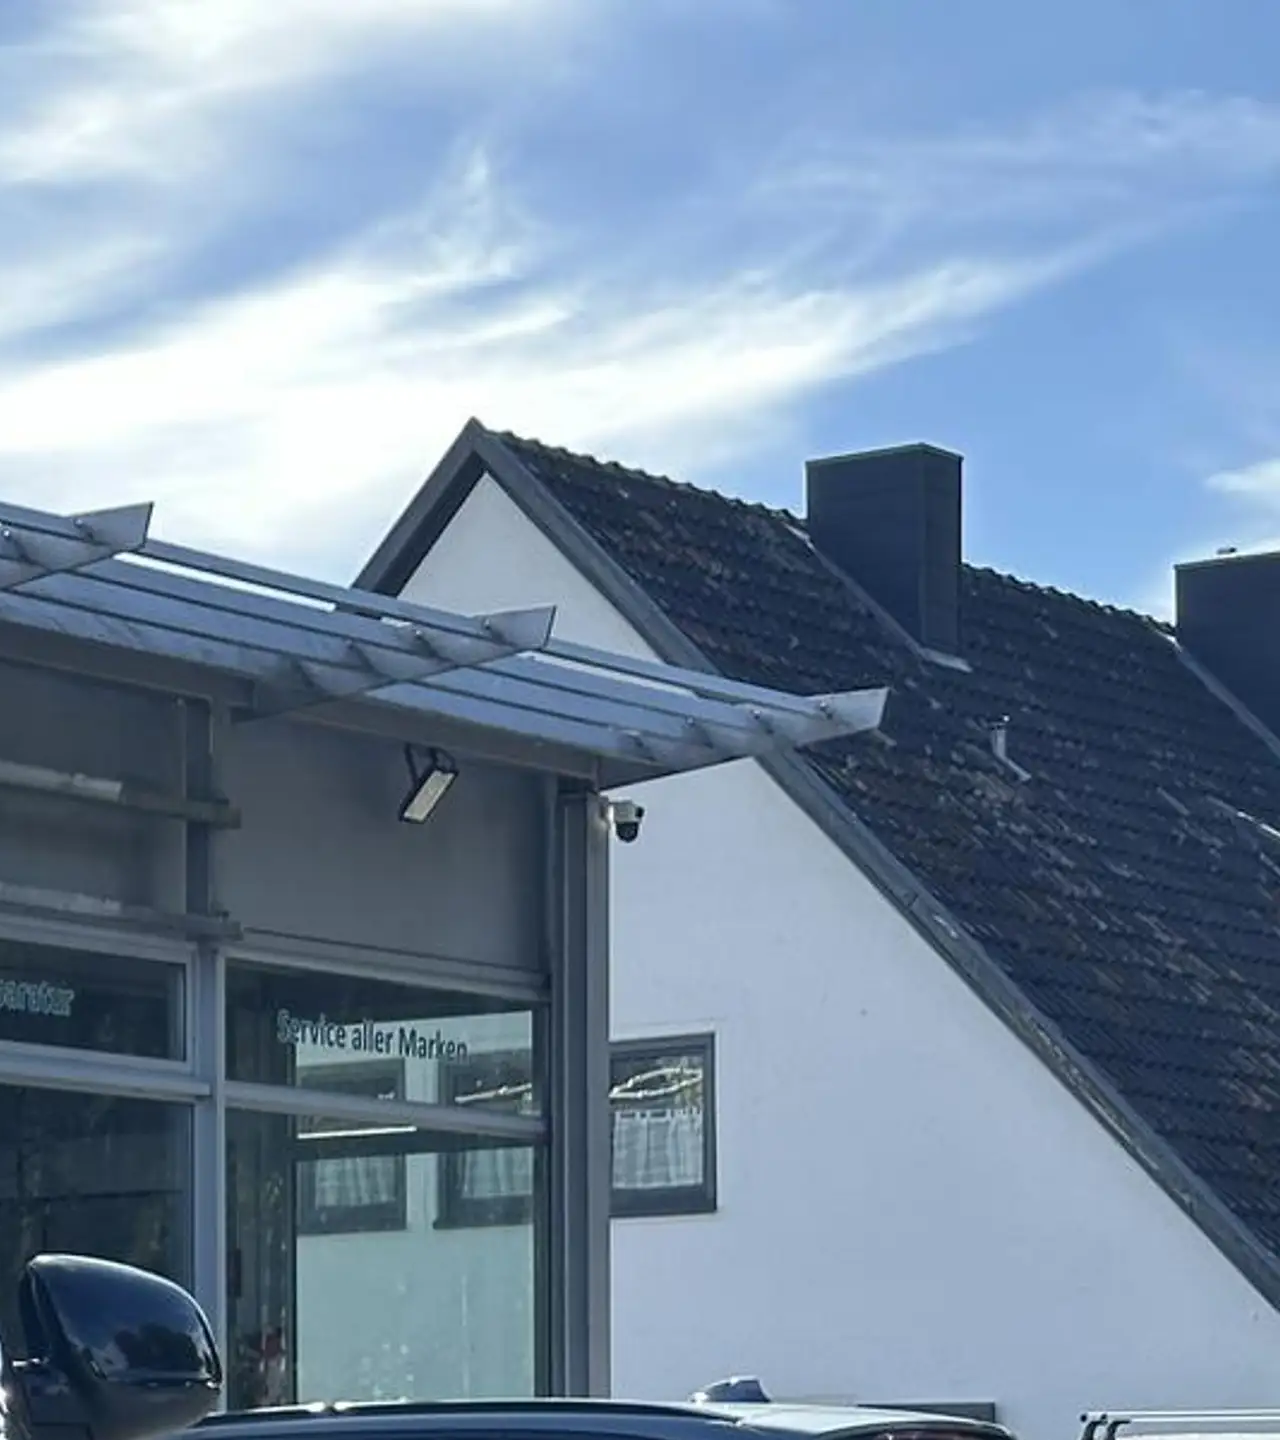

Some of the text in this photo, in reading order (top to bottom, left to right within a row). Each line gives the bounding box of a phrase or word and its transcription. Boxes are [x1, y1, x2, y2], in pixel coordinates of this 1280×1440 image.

[276, 1008, 468, 1064] Service aller Marken
